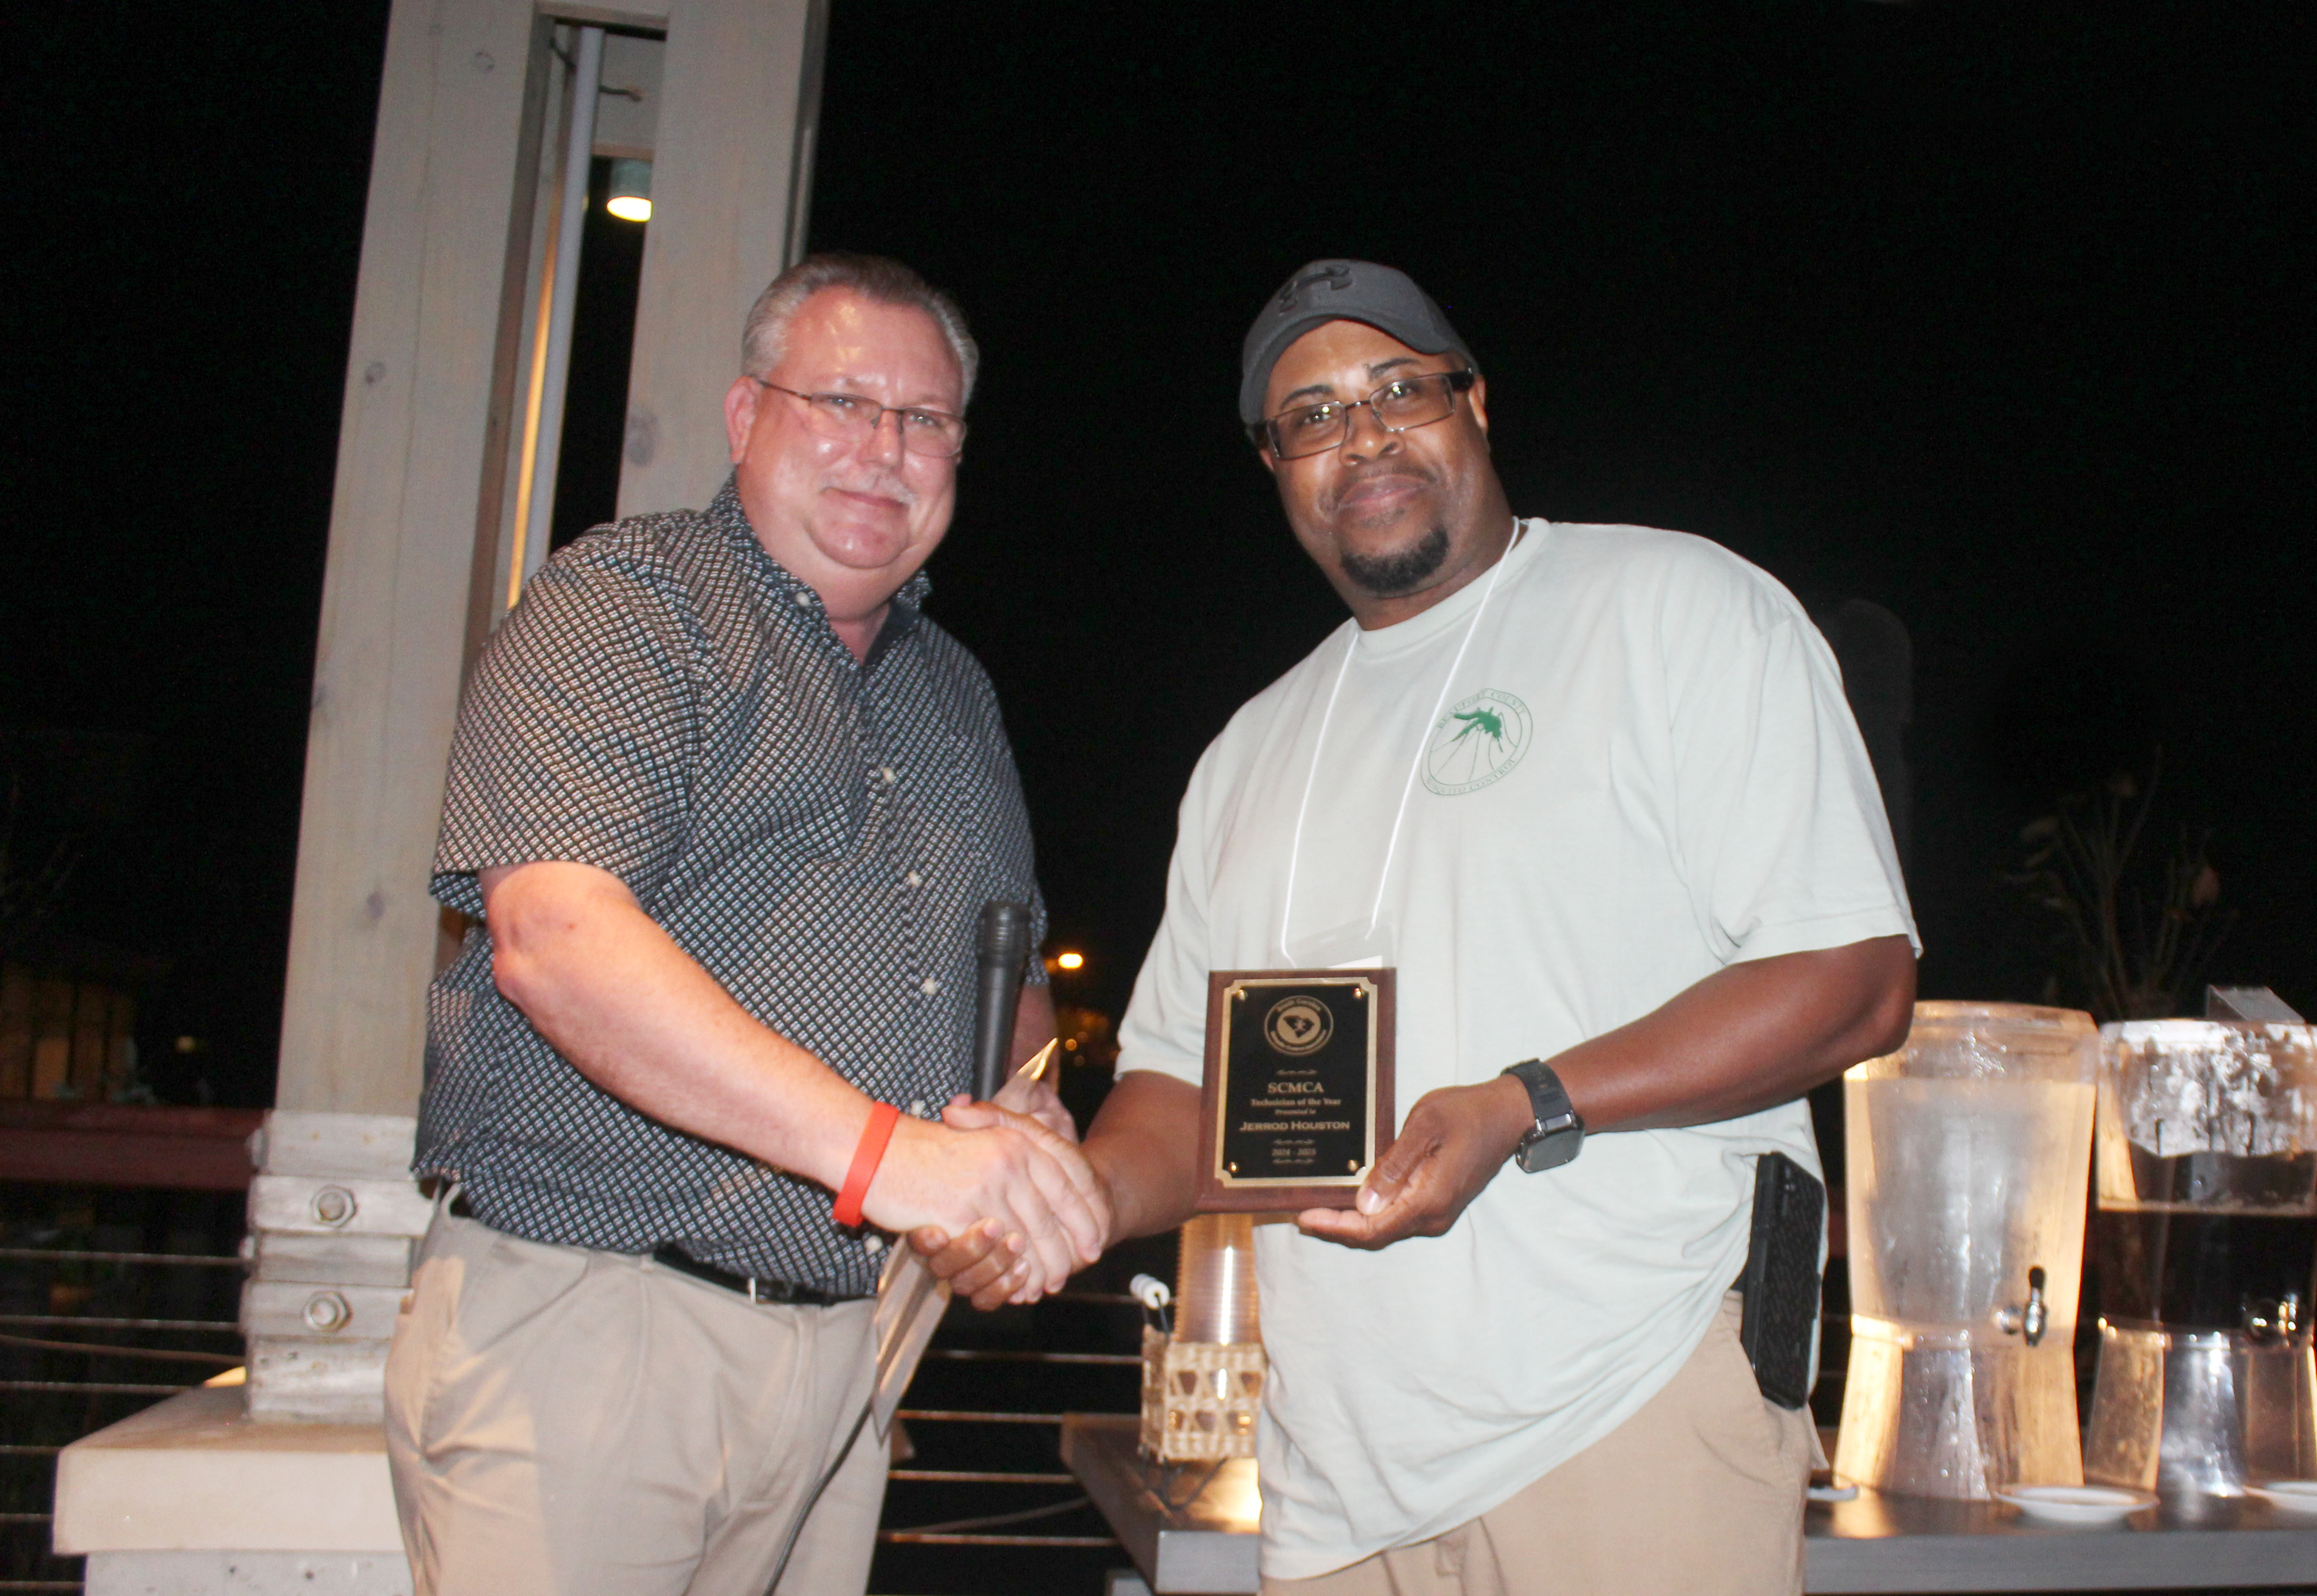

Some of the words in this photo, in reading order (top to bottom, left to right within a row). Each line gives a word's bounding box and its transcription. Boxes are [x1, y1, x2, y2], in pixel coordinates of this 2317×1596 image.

[1469, 759, 1516, 791] CONTROL
[1267, 1081, 1324, 1093] SCMCA
[1251, 1098, 1296, 1107] Technician
[1308, 1098, 1321, 1106] the
[1323, 1098, 1341, 1106] Year
[1239, 1121, 1288, 1132] JERROD
[1291, 1120, 1350, 1131] HOUSTON
